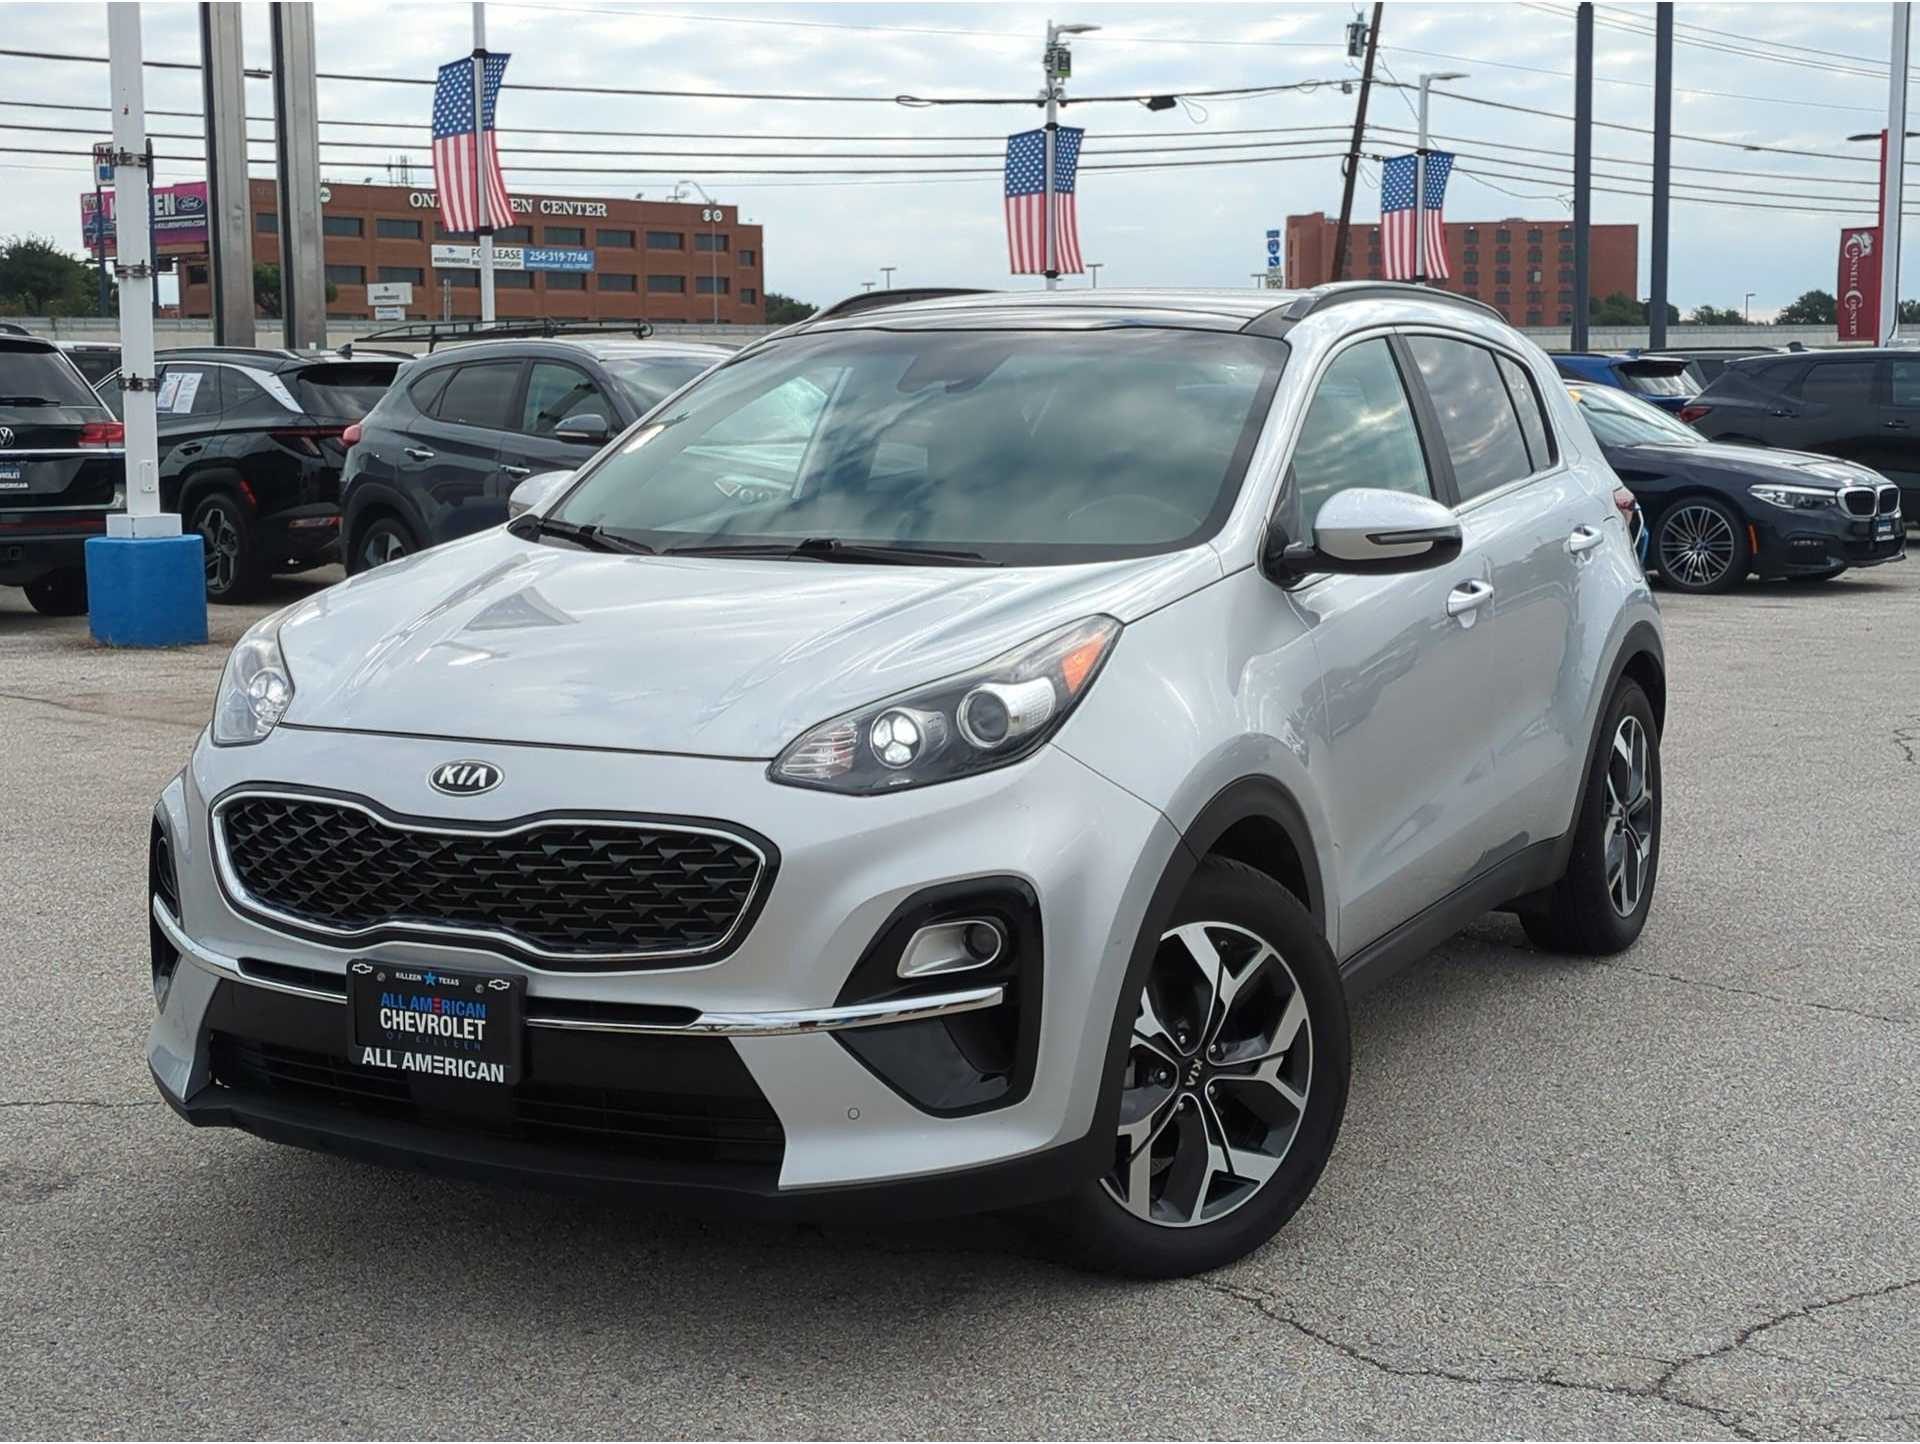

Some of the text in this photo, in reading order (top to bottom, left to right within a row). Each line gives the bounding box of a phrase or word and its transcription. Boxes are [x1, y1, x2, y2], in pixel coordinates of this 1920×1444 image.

[409, 192, 440, 208] ON
[540, 200, 608, 217] CENTER
[493, 249, 521, 260] LEASE
[438, 765, 488, 787] KIA
[395, 971, 460, 986] KILLEEN TEXAS
[381, 992, 486, 1019] ALL AMERICAN
[380, 1008, 486, 1041] CHEVROLET
[362, 1047, 505, 1083] ALL AMERICAN
[1185, 1058, 1203, 1086] KIA
